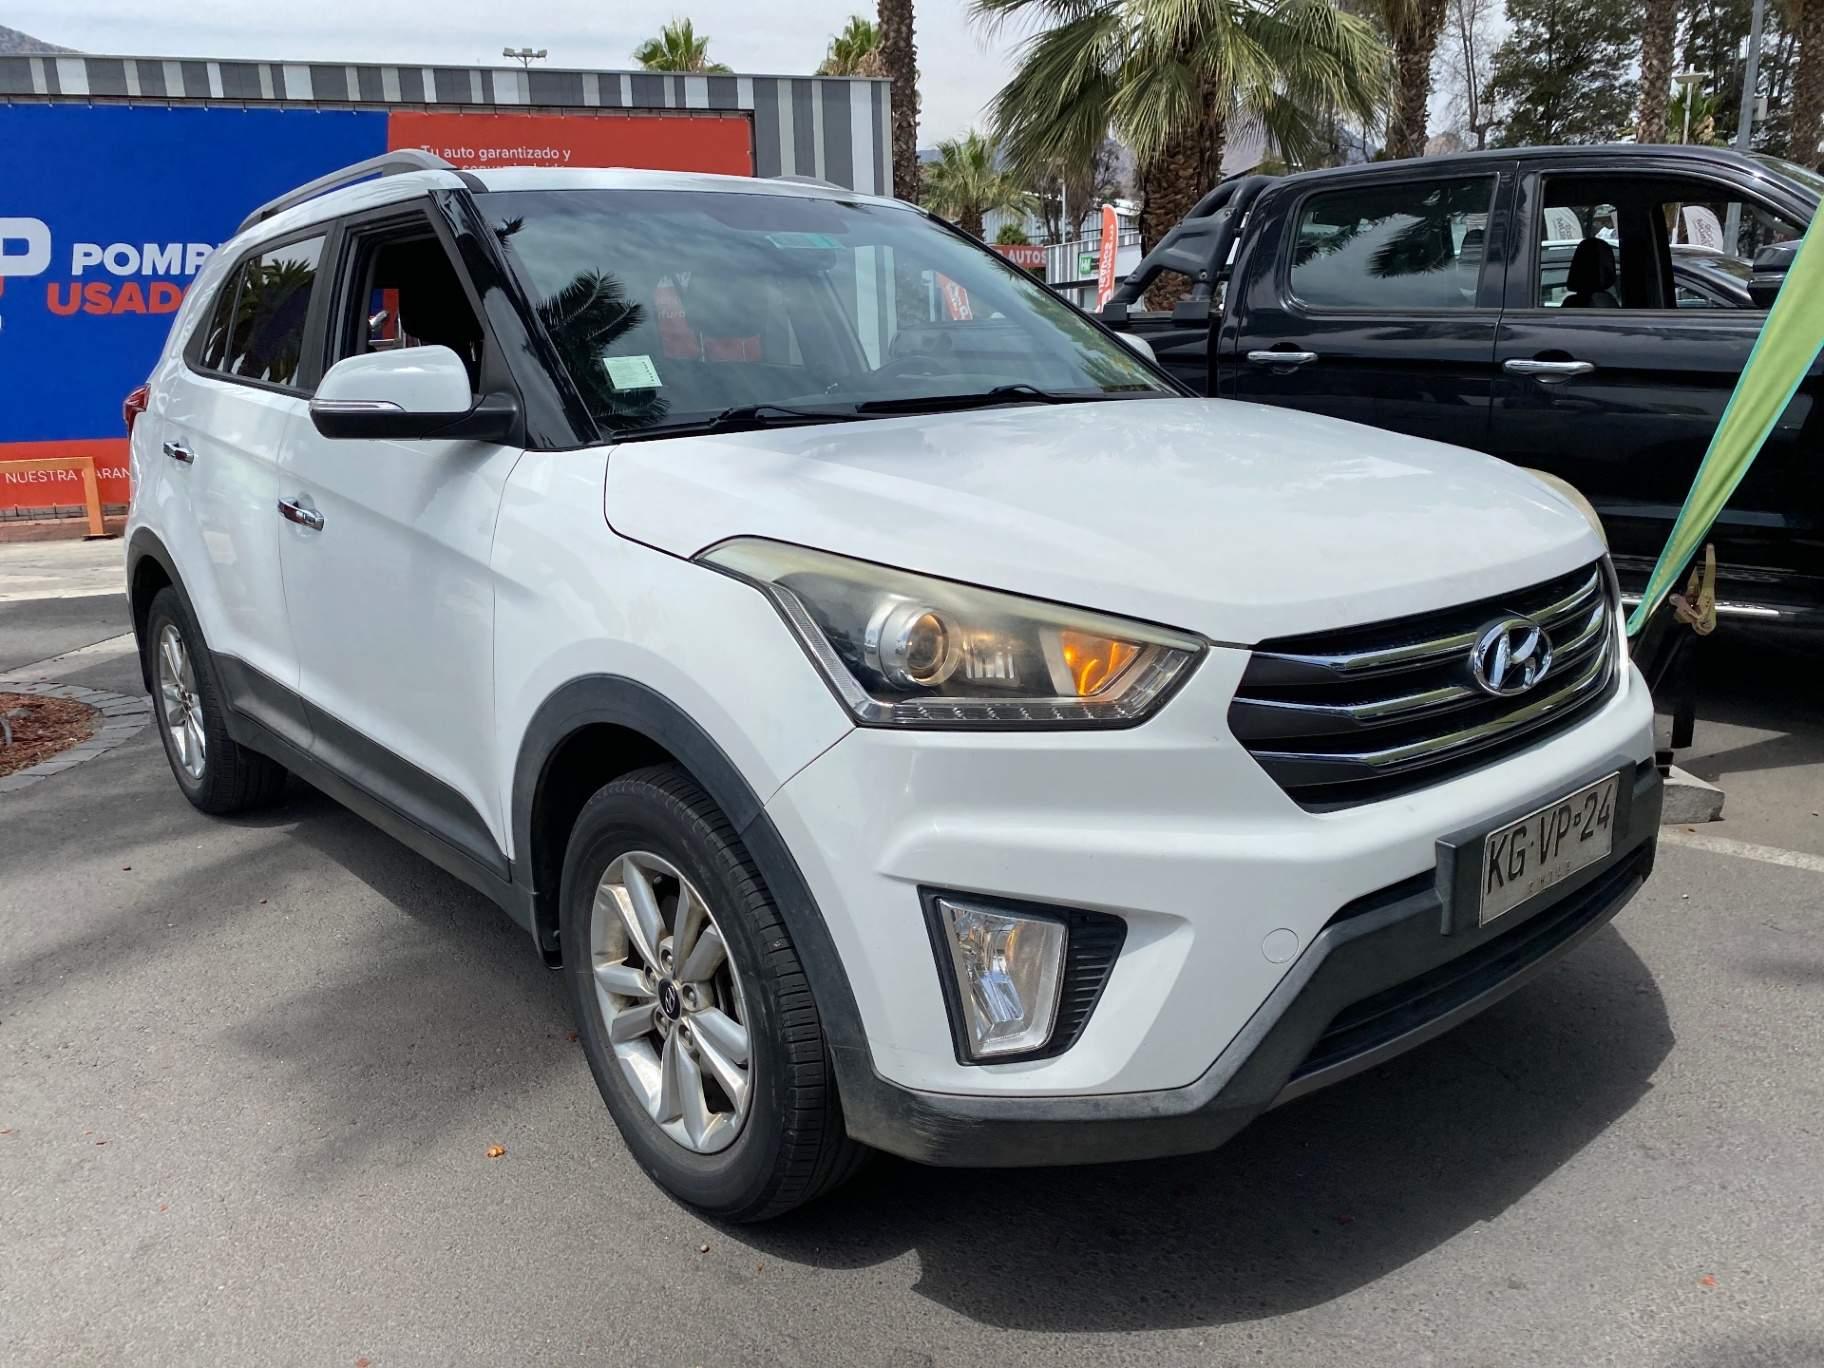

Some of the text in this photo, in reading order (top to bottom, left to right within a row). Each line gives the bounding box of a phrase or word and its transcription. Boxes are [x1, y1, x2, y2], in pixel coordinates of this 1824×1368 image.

[444, 147, 475, 159] auto
[478, 146, 560, 161] garantizado
[563, 150, 571, 161] y
[72, 242, 226, 276] POMP
[47, 282, 192, 315] USAD
[5, 469, 78, 483] NUESTRA
